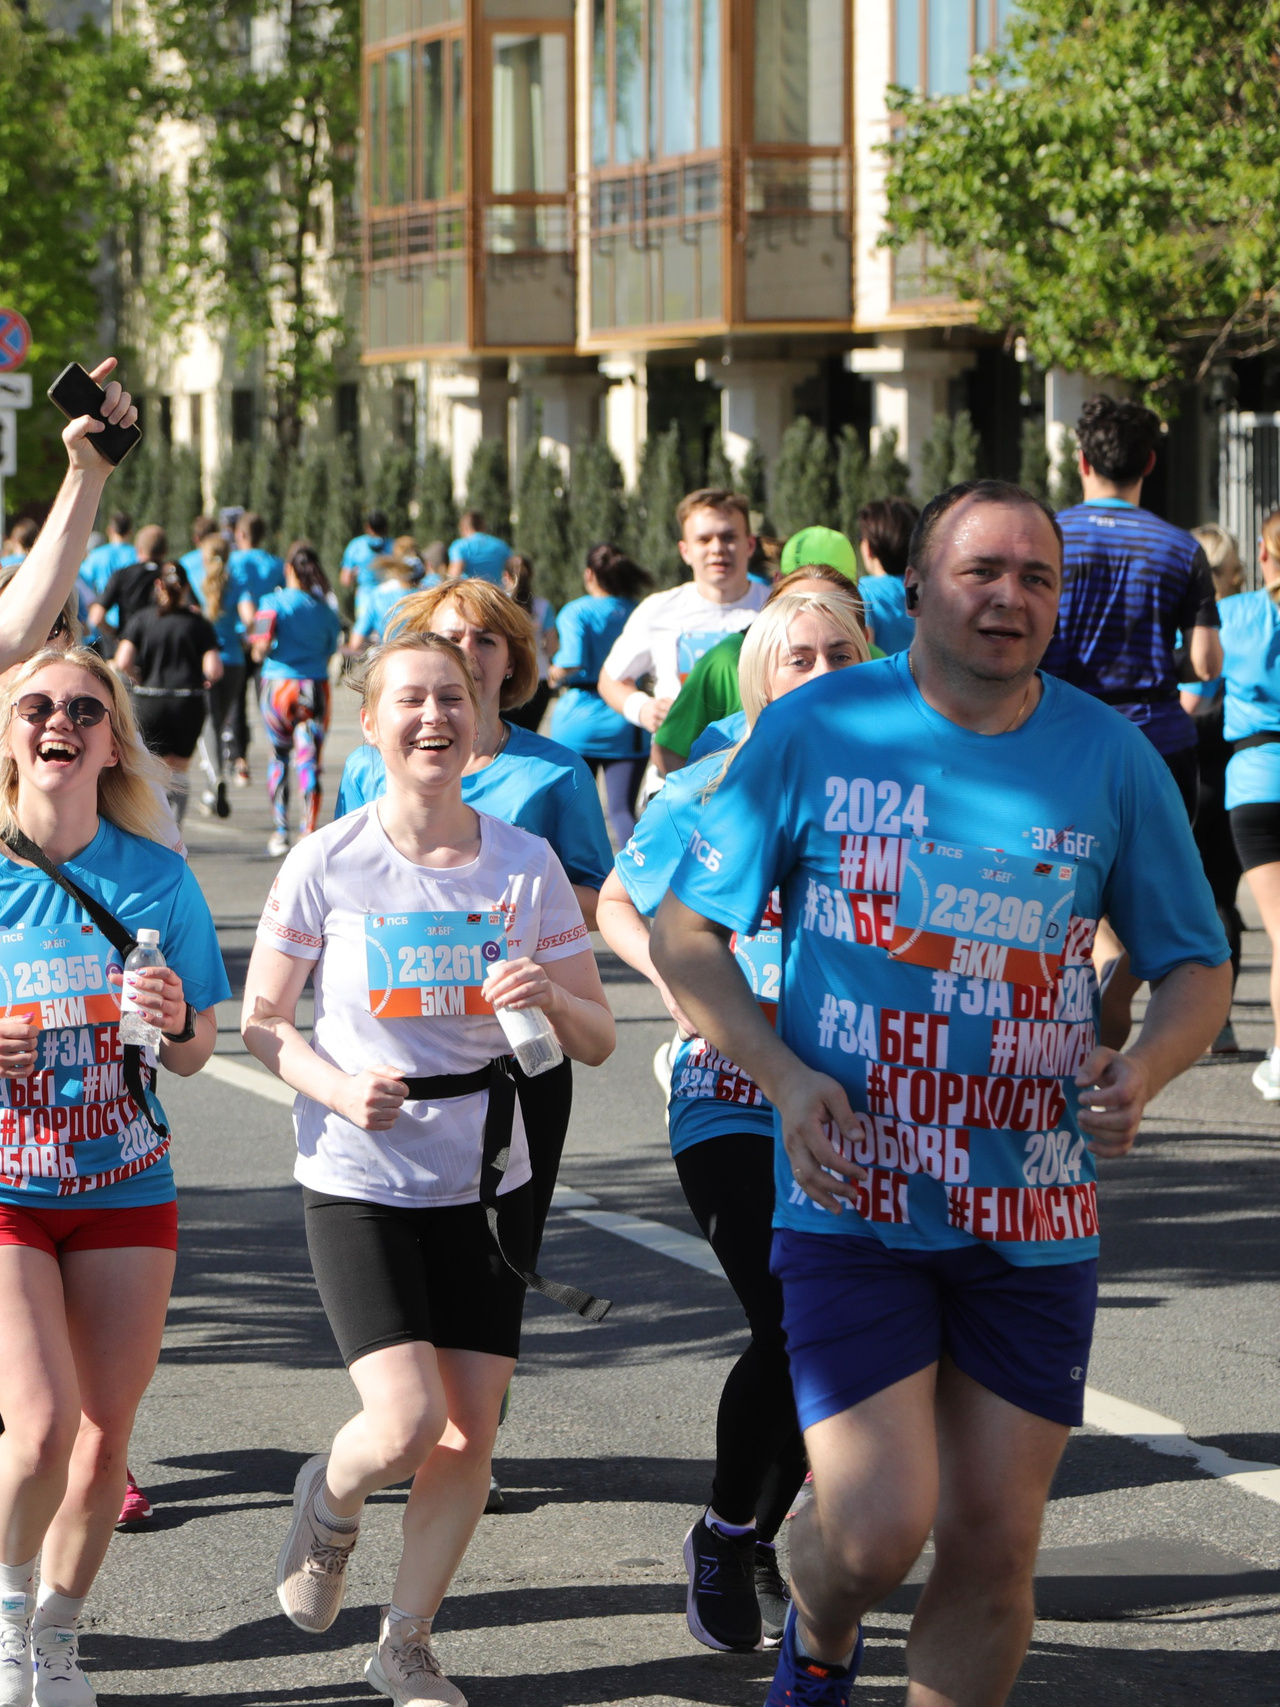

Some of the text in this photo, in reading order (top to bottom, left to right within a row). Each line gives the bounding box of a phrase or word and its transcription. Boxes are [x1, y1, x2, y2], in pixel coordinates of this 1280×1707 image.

[824, 776, 929, 837] 2024
[688, 829, 723, 872] ПСБ
[937, 845, 963, 859] ПСБ
[387, 916, 409, 926] ПСБ
[804, 878, 900, 947] #ЗАБЕ
[929, 883, 1043, 944] 23296
[3, 933, 24, 944] ПСБ
[757, 934, 779, 944] ПСБ
[14, 954, 102, 998] 23355
[398, 944, 482, 983] 23261
[43, 1026, 122, 1067] #ЗАБЕ
[818, 994, 950, 1069] #ЗАБЕГ
[675, 1068, 763, 1106] #ЗАБЕГ
[866, 1060, 1067, 1132] #ГОРДОСТЬ
[1023, 1131, 1083, 1185] 2024
